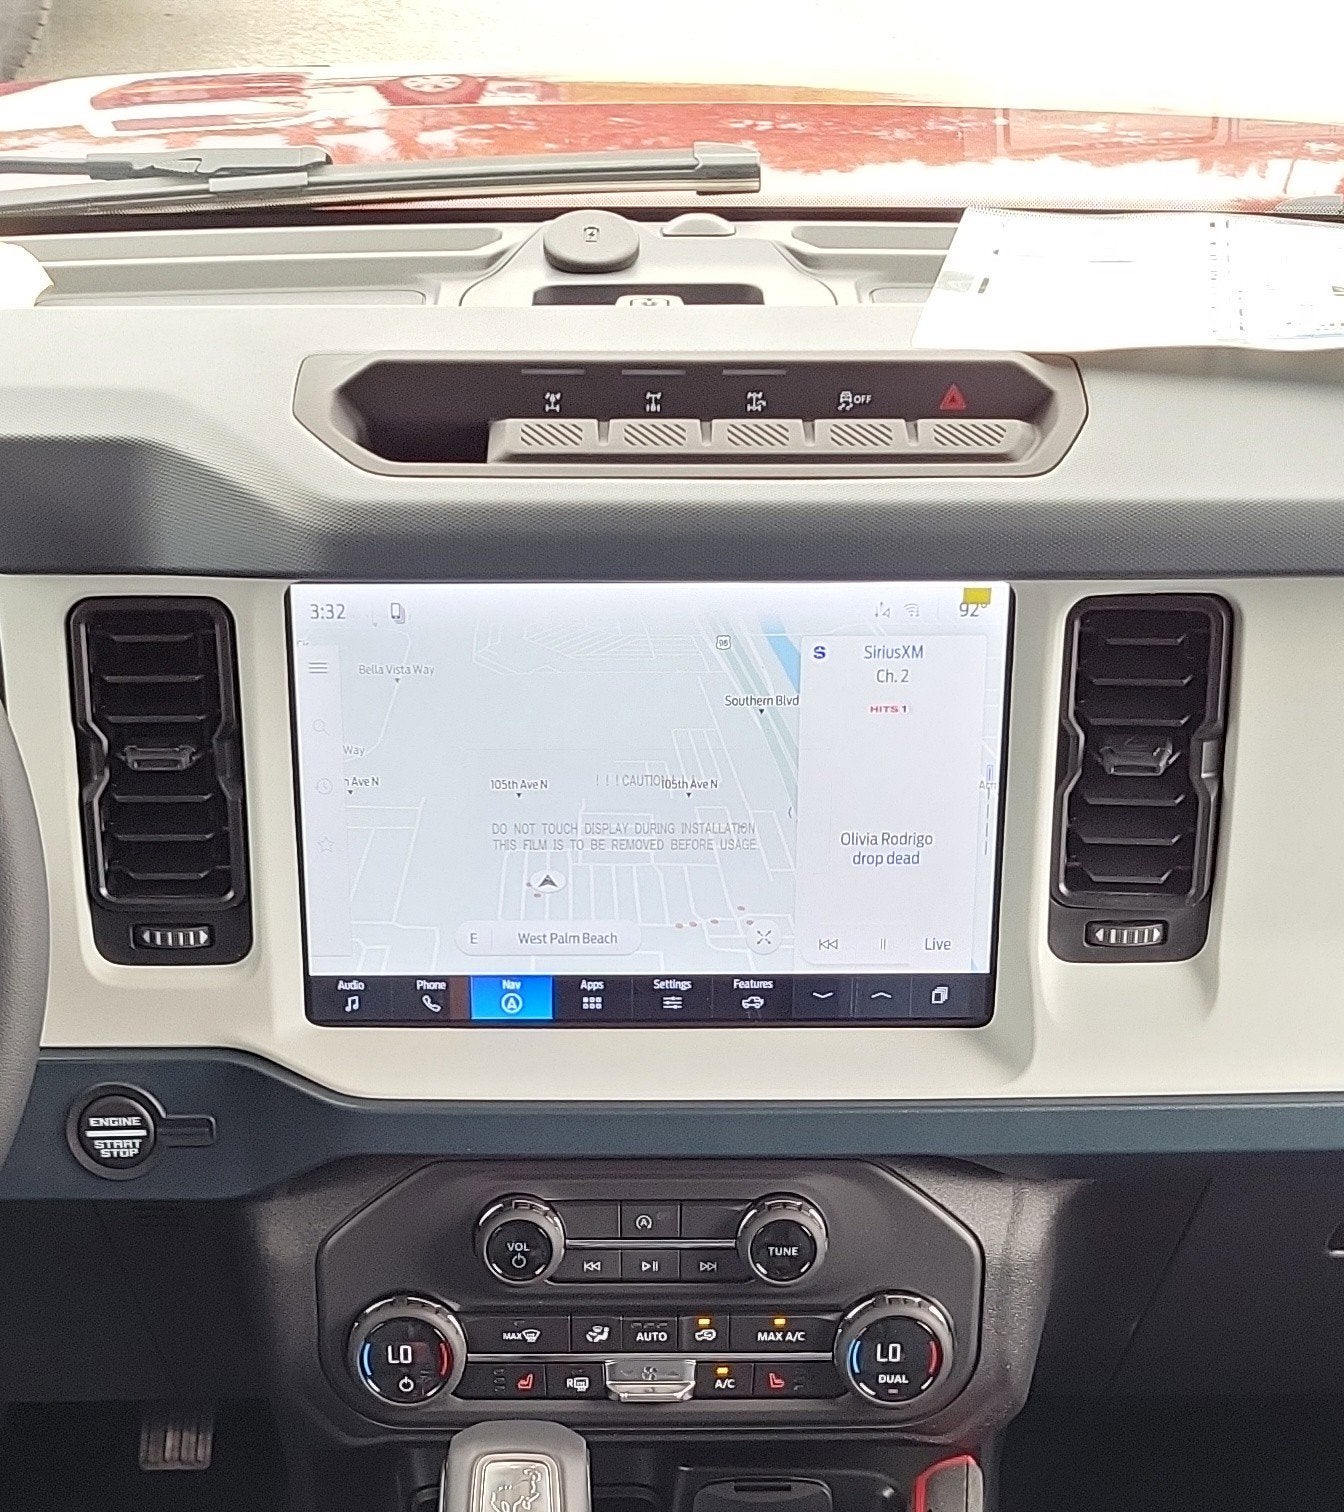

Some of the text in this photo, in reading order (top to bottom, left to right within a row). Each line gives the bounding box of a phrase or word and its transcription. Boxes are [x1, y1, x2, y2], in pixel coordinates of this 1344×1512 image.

[853, 393, 872, 405] OFF
[310, 603, 346, 620] 3:32
[864, 645, 924, 660] SiriusXM
[358, 664, 435, 677] Bella Vista Way
[876, 669, 909, 684] Ch. 2
[725, 694, 800, 707] Southern Blvd
[870, 705, 899, 714] HITS
[342, 745, 365, 757] Way
[351, 776, 380, 787] Ave N
[490, 778, 548, 790] 105th Ave N
[690, 778, 708, 790] Ave
[710, 778, 718, 790] N
[492, 822, 756, 835] DO NOT TOUCH DISPLAY DURING INSTALLATION
[493, 839, 756, 851] THIS FILM IS TO BE REMOVED BEFORE USAGE
[840, 832, 933, 848] Olivia Rodrigo
[853, 851, 920, 867] drop dead
[518, 932, 548, 945] West
[550, 932, 581, 945] Palm
[582, 932, 618, 945] Beach
[924, 937, 951, 950] Live
[338, 979, 365, 991] Audio
[416, 979, 447, 991] Phone
[502, 979, 522, 991] Nav
[580, 979, 605, 992] Apps
[653, 978, 692, 992] Settings
[733, 978, 774, 990] Features
[88, 1117, 142, 1127] ENGINE
[93, 1139, 142, 1149] START
[100, 1149, 139, 1158] STOP
[507, 1241, 531, 1253] VOL
[768, 1246, 799, 1257] TUNE
[503, 1332, 522, 1340] MAX
[636, 1331, 668, 1342] AUTO
[757, 1331, 806, 1342] MAX A/C
[387, 1345, 412, 1364] LO
[876, 1343, 901, 1363] LO
[715, 1378, 735, 1389] A/C
[878, 1374, 909, 1384] DUAL
